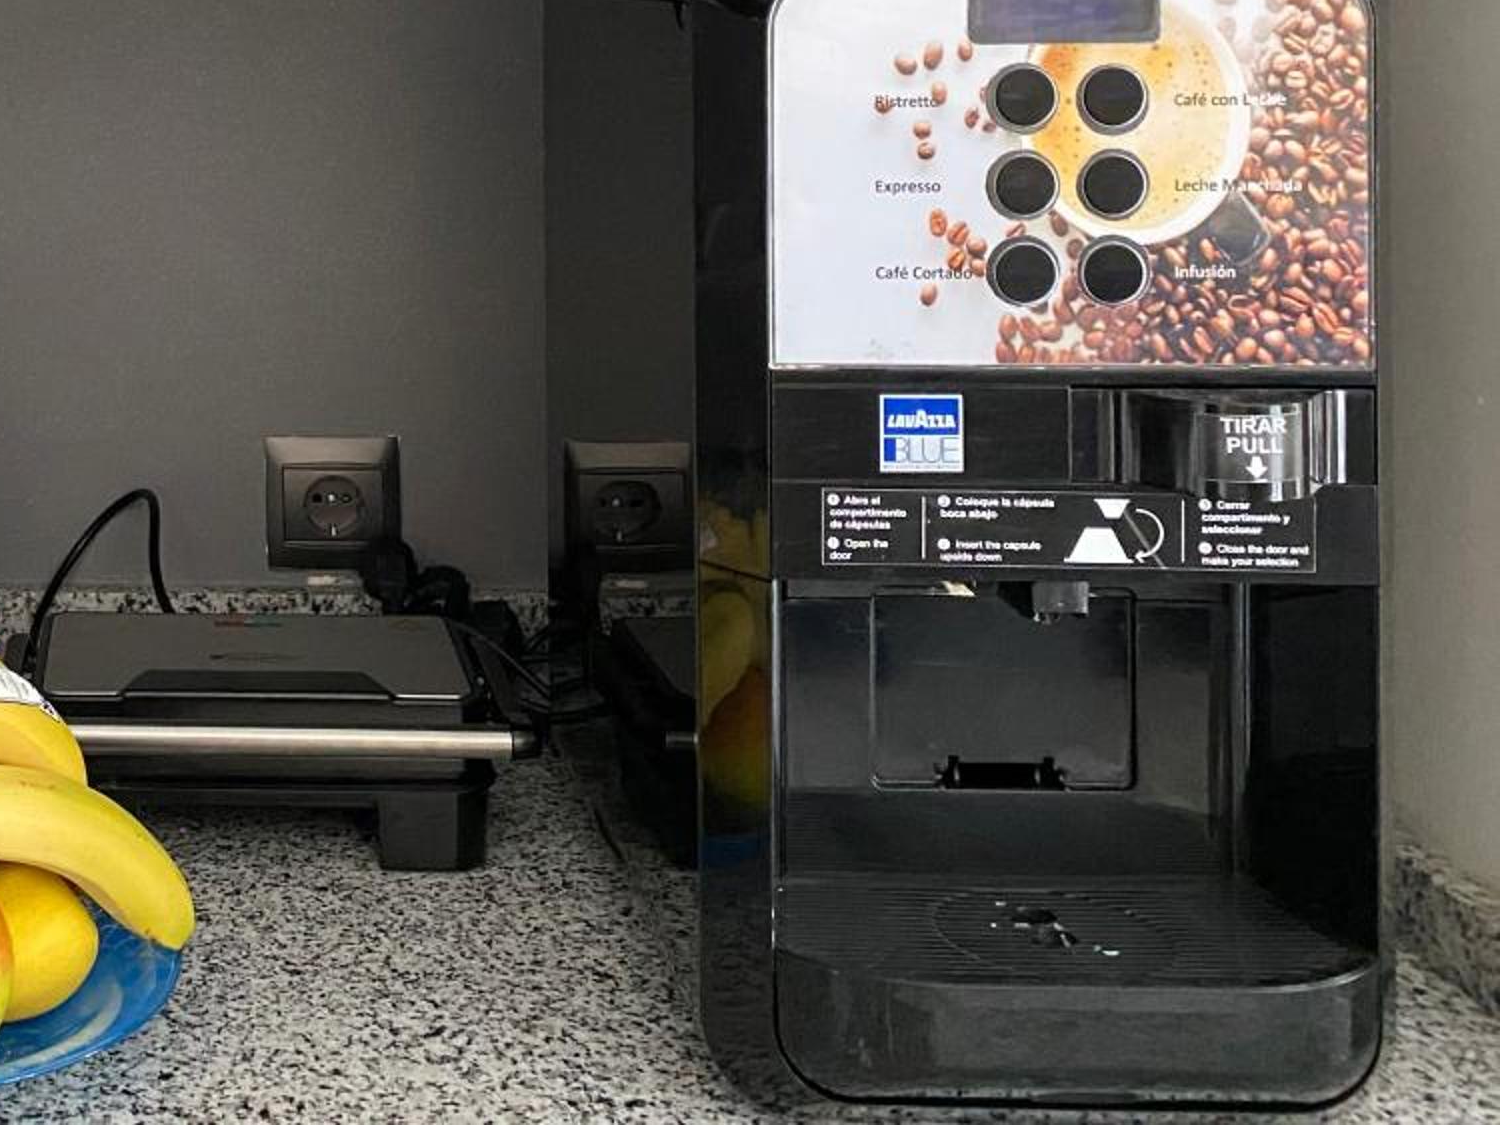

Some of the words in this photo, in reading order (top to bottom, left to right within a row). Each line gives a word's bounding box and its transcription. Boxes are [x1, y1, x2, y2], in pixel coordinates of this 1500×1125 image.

[874, 95, 940, 108] Ristretto
[1174, 93, 1207, 106] Café
[1211, 96, 1239, 106] con
[875, 180, 942, 195] Expresso
[1174, 178, 1219, 192] Leche
[875, 266, 909, 280] Café
[913, 266, 973, 280] Cortado
[1174, 264, 1237, 279] Infusión
[887, 409, 957, 428] LAVAZZA
[1219, 416, 1287, 434] TIRAR
[884, 437, 960, 464] BLUE
[1226, 437, 1284, 454] PULL
[1282, 515, 1291, 525] y
[844, 538, 871, 550] Open
[1265, 544, 1289, 554] door
[829, 550, 853, 560] door
